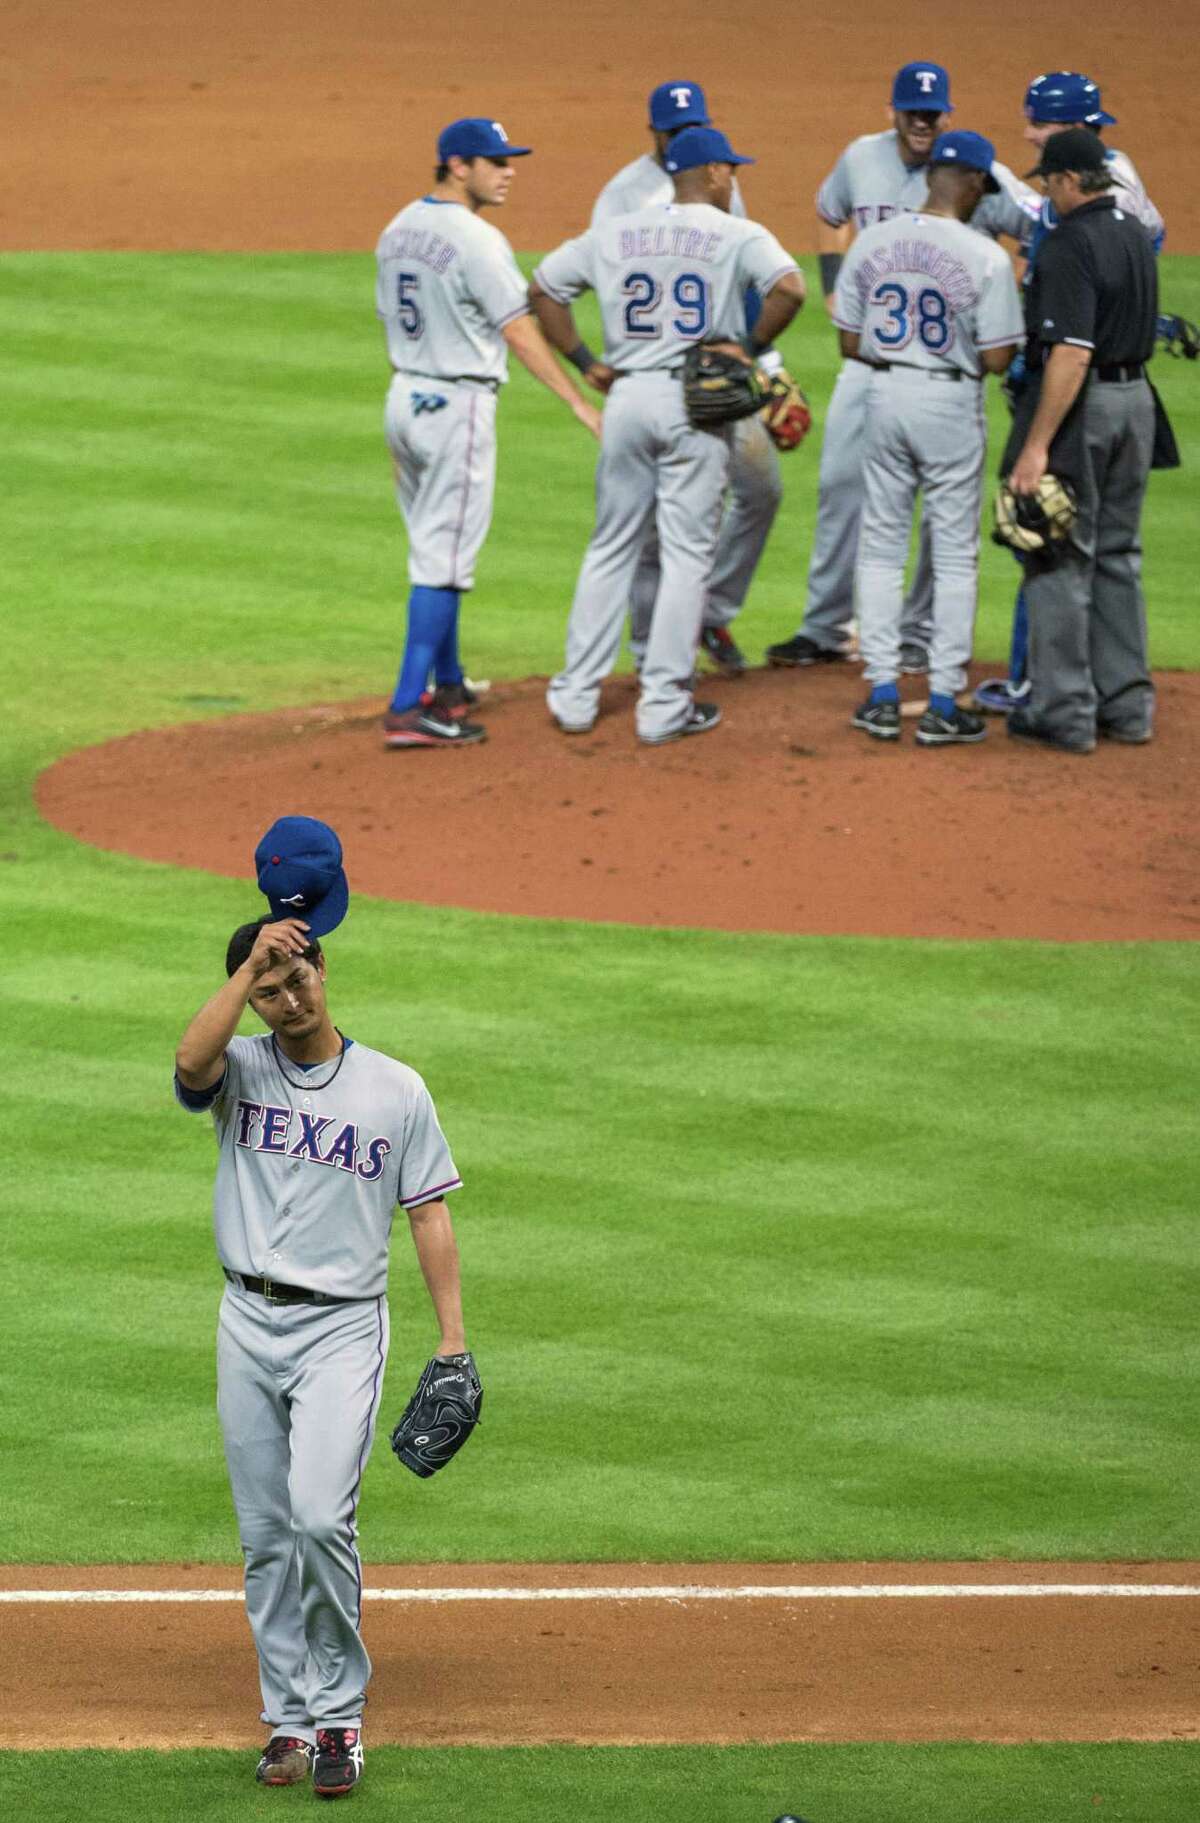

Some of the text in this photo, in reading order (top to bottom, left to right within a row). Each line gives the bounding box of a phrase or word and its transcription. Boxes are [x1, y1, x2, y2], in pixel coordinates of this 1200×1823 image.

[670, 87, 692, 108] T
[914, 71, 938, 93] T
[618, 224, 725, 263] BELTRE
[397, 271, 425, 341] 5
[621, 271, 712, 340] 29
[871, 282, 955, 356] 38
[234, 1099, 392, 1182] TEXAS
